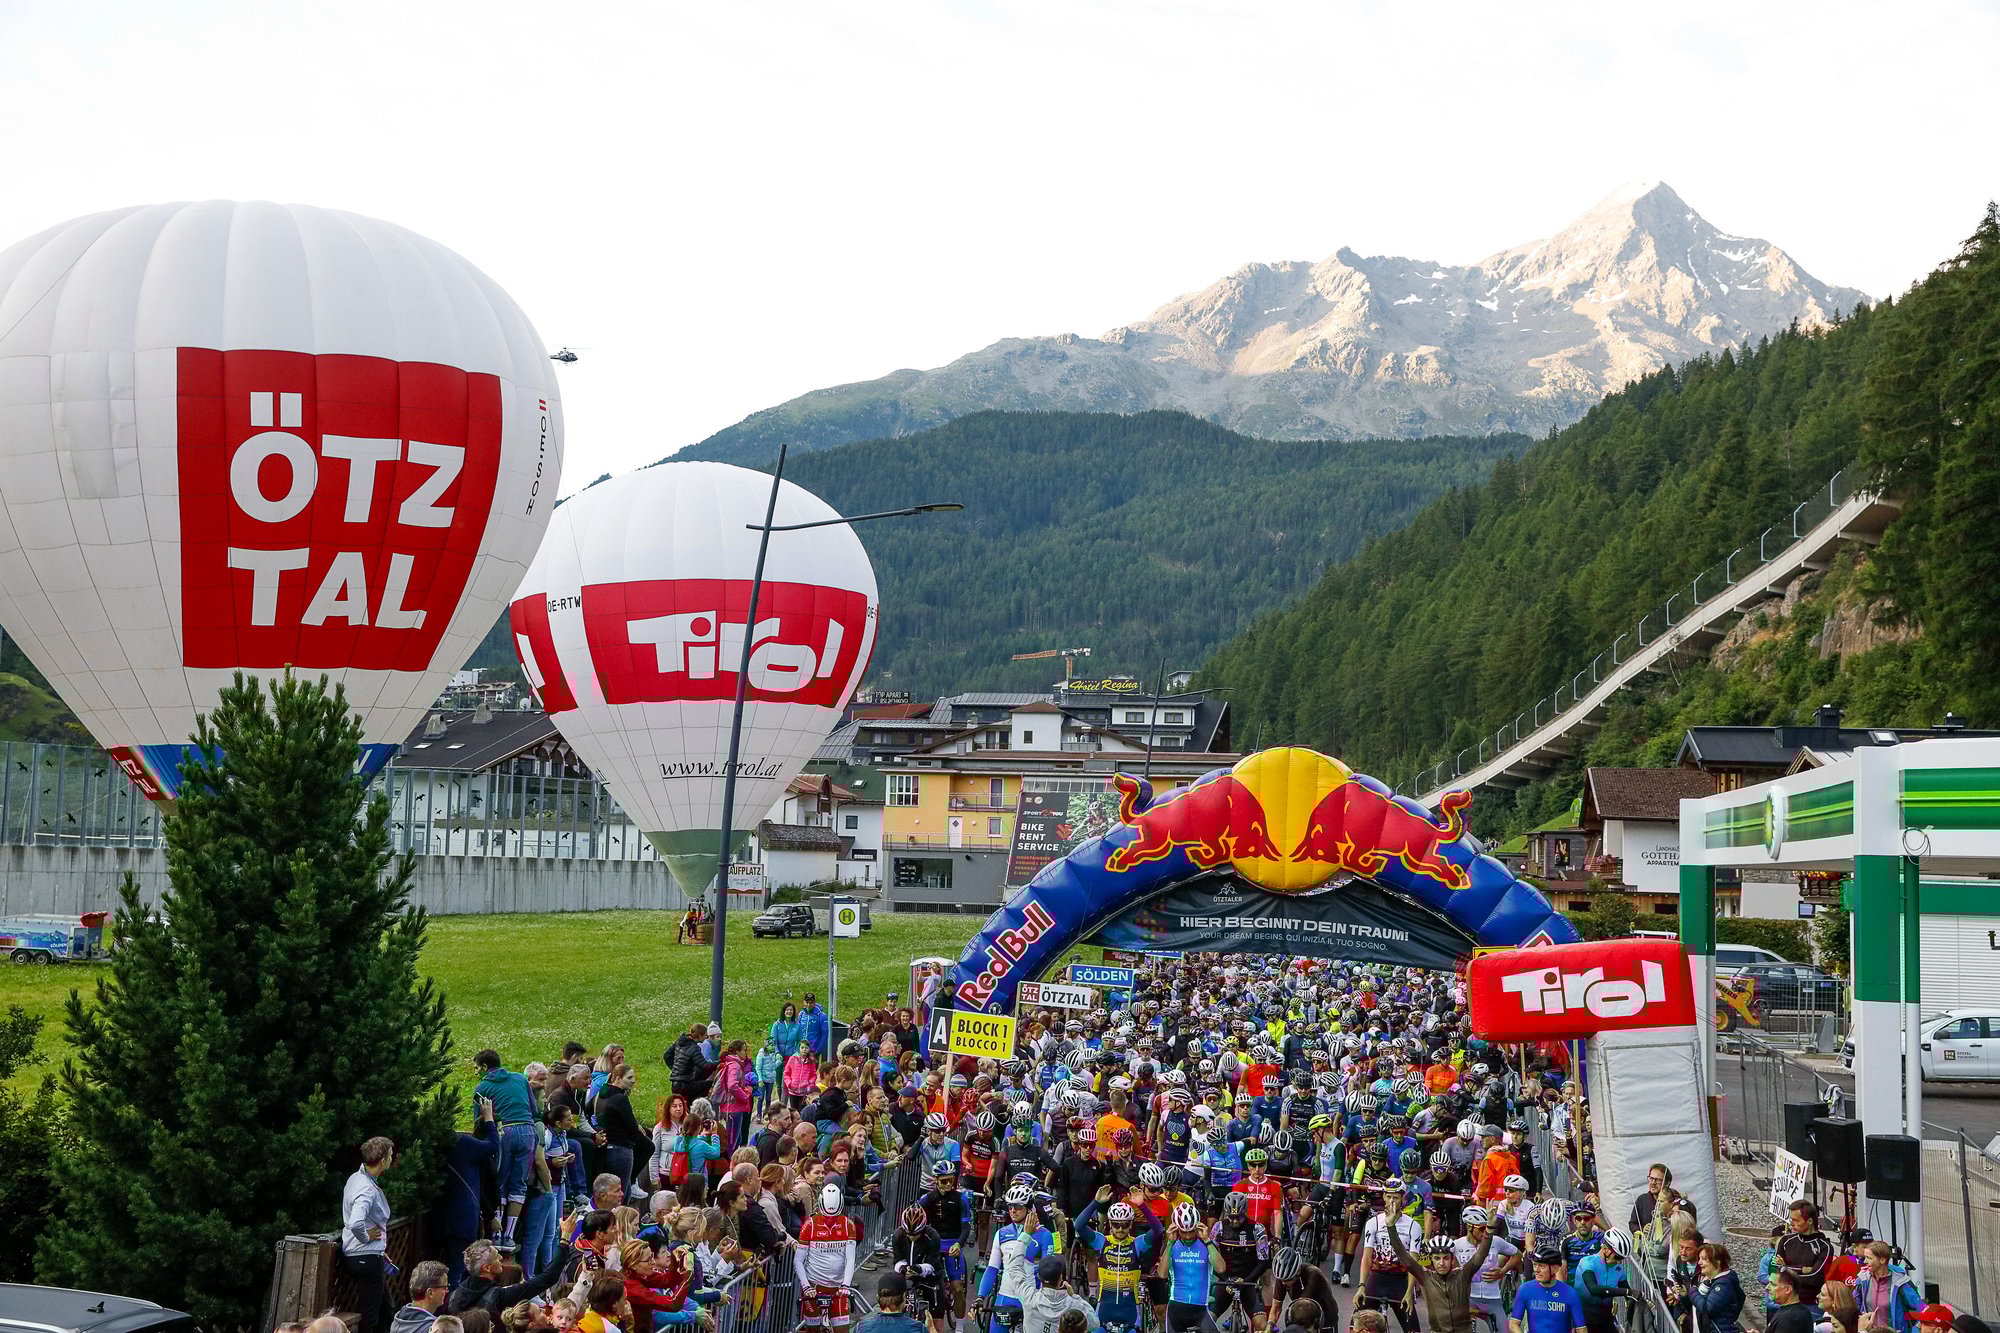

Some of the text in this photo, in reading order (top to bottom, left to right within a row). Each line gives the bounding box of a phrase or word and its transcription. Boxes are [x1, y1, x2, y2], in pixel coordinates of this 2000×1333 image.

[230, 391, 466, 527] ÖTZ
[227, 546, 428, 630] TAL
[547, 596, 581, 613] OE-RTW
[627, 610, 845, 692] Tirol
[1069, 679, 1139, 693] Hotel Regina
[660, 757, 783, 777] www.trol.at
[1019, 832, 1046, 841] RENT
[1020, 822, 1045, 832] BIKE
[1017, 842, 1060, 852] SERVICE
[1180, 916, 1410, 942] HIER BEGINNT DEIN TRAUM!
[1200, 931, 1388, 951] YOUR DREAM BEGINS. QUI INIZIA IL TUO SOGNO.
[955, 899, 1056, 1011] Red Bull
[1075, 968, 1129, 981] SÖLDEN
[1021, 985, 1039, 994] ÖTZ
[1021, 993, 1038, 1002] TAL
[1041, 986, 1089, 1006] ÖTZTAL
[1501, 960, 1666, 1018] Tirol
[932, 1016, 948, 1045] A
[958, 1019, 1008, 1038] BLOCK 1
[956, 1036, 1006, 1052] BLOCCO 1
[1776, 1155, 1807, 1184] SUPER!
